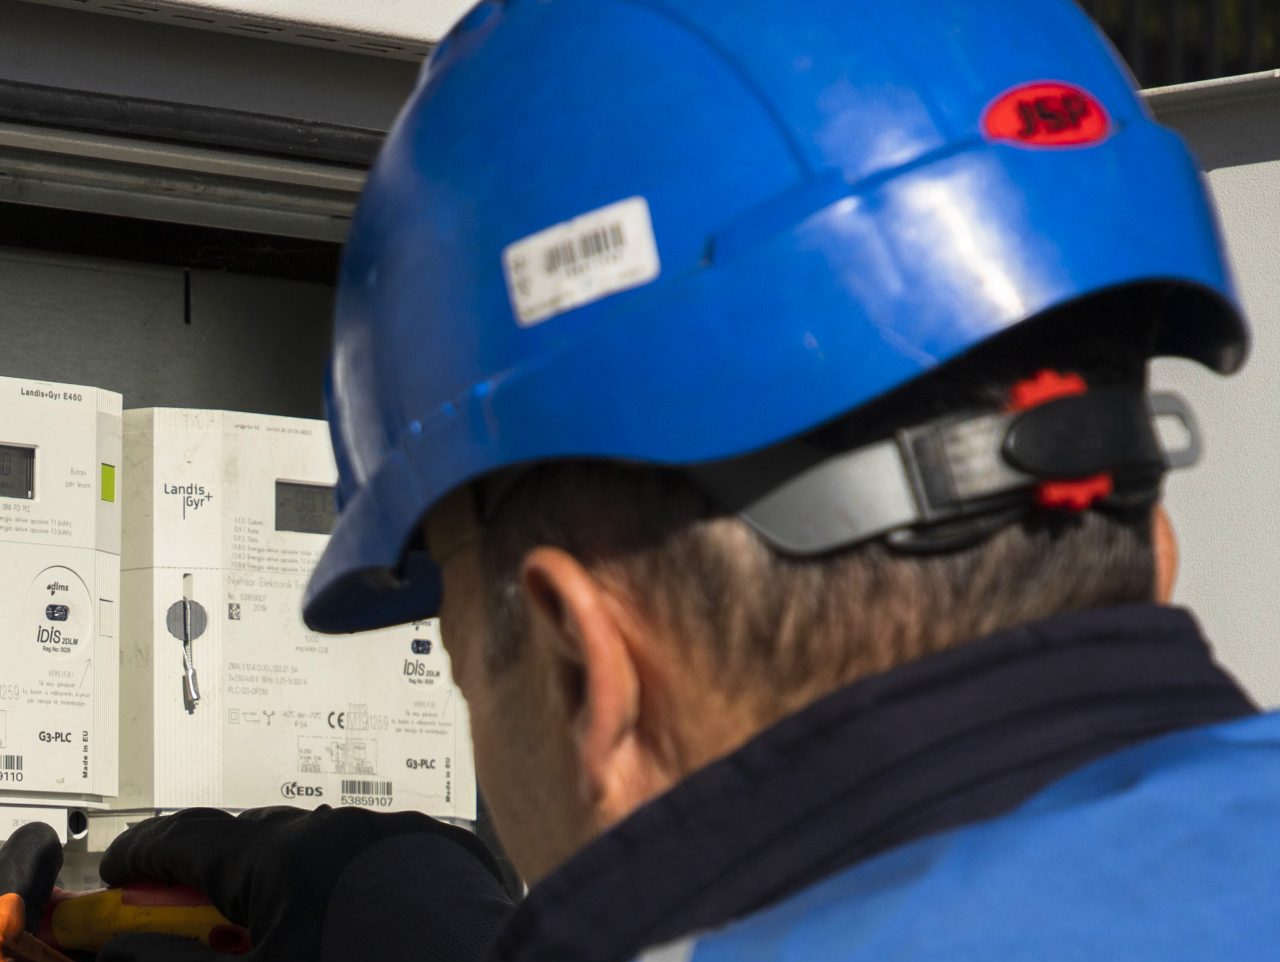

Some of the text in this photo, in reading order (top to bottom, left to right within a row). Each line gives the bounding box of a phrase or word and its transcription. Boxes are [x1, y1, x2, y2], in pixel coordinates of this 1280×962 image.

[1016, 92, 1090, 139] JSP
[164, 483, 205, 496] Landis
[61, 637, 78, 645] 2DLM
[42, 645, 51, 653] Reg
[38, 730, 71, 744] G3-PLC
[82, 730, 88, 742] EU
[81, 744, 88, 753] in
[405, 757, 435, 770] G3-PLC
[285, 780, 323, 797] KEDS
[341, 794, 392, 806] 53859107
